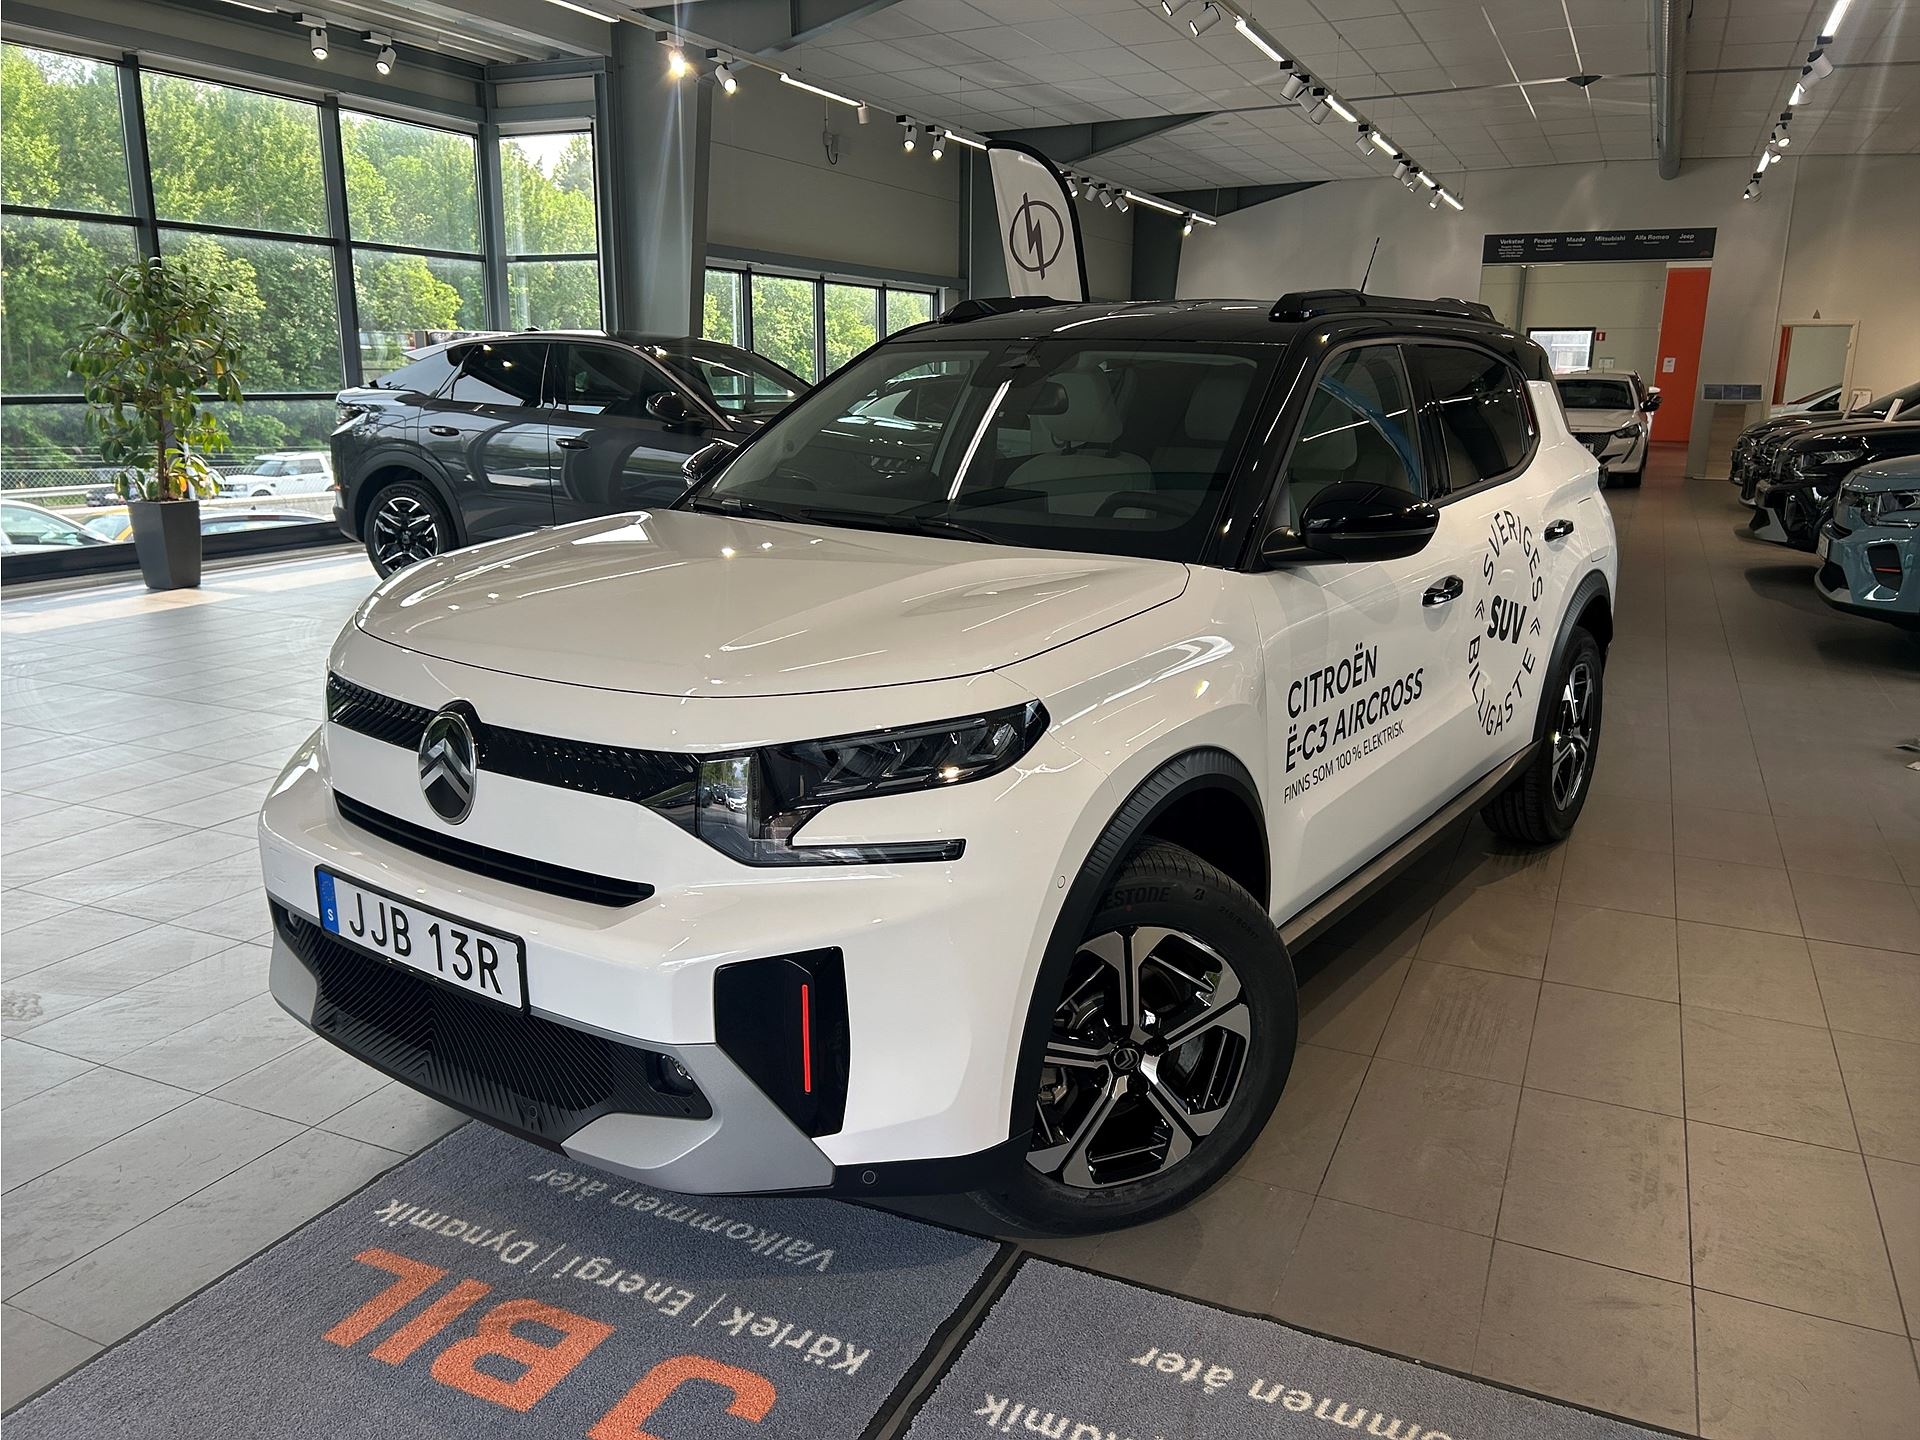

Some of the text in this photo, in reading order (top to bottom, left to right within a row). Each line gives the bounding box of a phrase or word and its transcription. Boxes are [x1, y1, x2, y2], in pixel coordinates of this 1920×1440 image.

[1533, 237, 1557, 245] Peugeot
[1679, 233, 1695, 241] Jeep
[1483, 510, 1543, 602] SVERIGES
[1486, 595, 1527, 645] SUV
[1287, 642, 1378, 719] CITROËN
[1467, 634, 1536, 736] BILLIGASTE
[1285, 667, 1424, 774] Ë-C3 AIRCROSS
[1284, 771, 1311, 804] FINNS
[1312, 759, 1334, 786] SOM
[1363, 719, 1405, 756] ELEKTRISK
[327, 908, 334, 922] S
[349, 892, 503, 995] JJB 13R
[375, 1199, 539, 1265] Dynamik
[528, 1168, 834, 1272] Välkommen åter
[552, 1256, 695, 1317] Energi
[322, 1247, 615, 1412] BIL
[719, 1305, 871, 1375] Kärlek
[1129, 1347, 1234, 1394] åter
